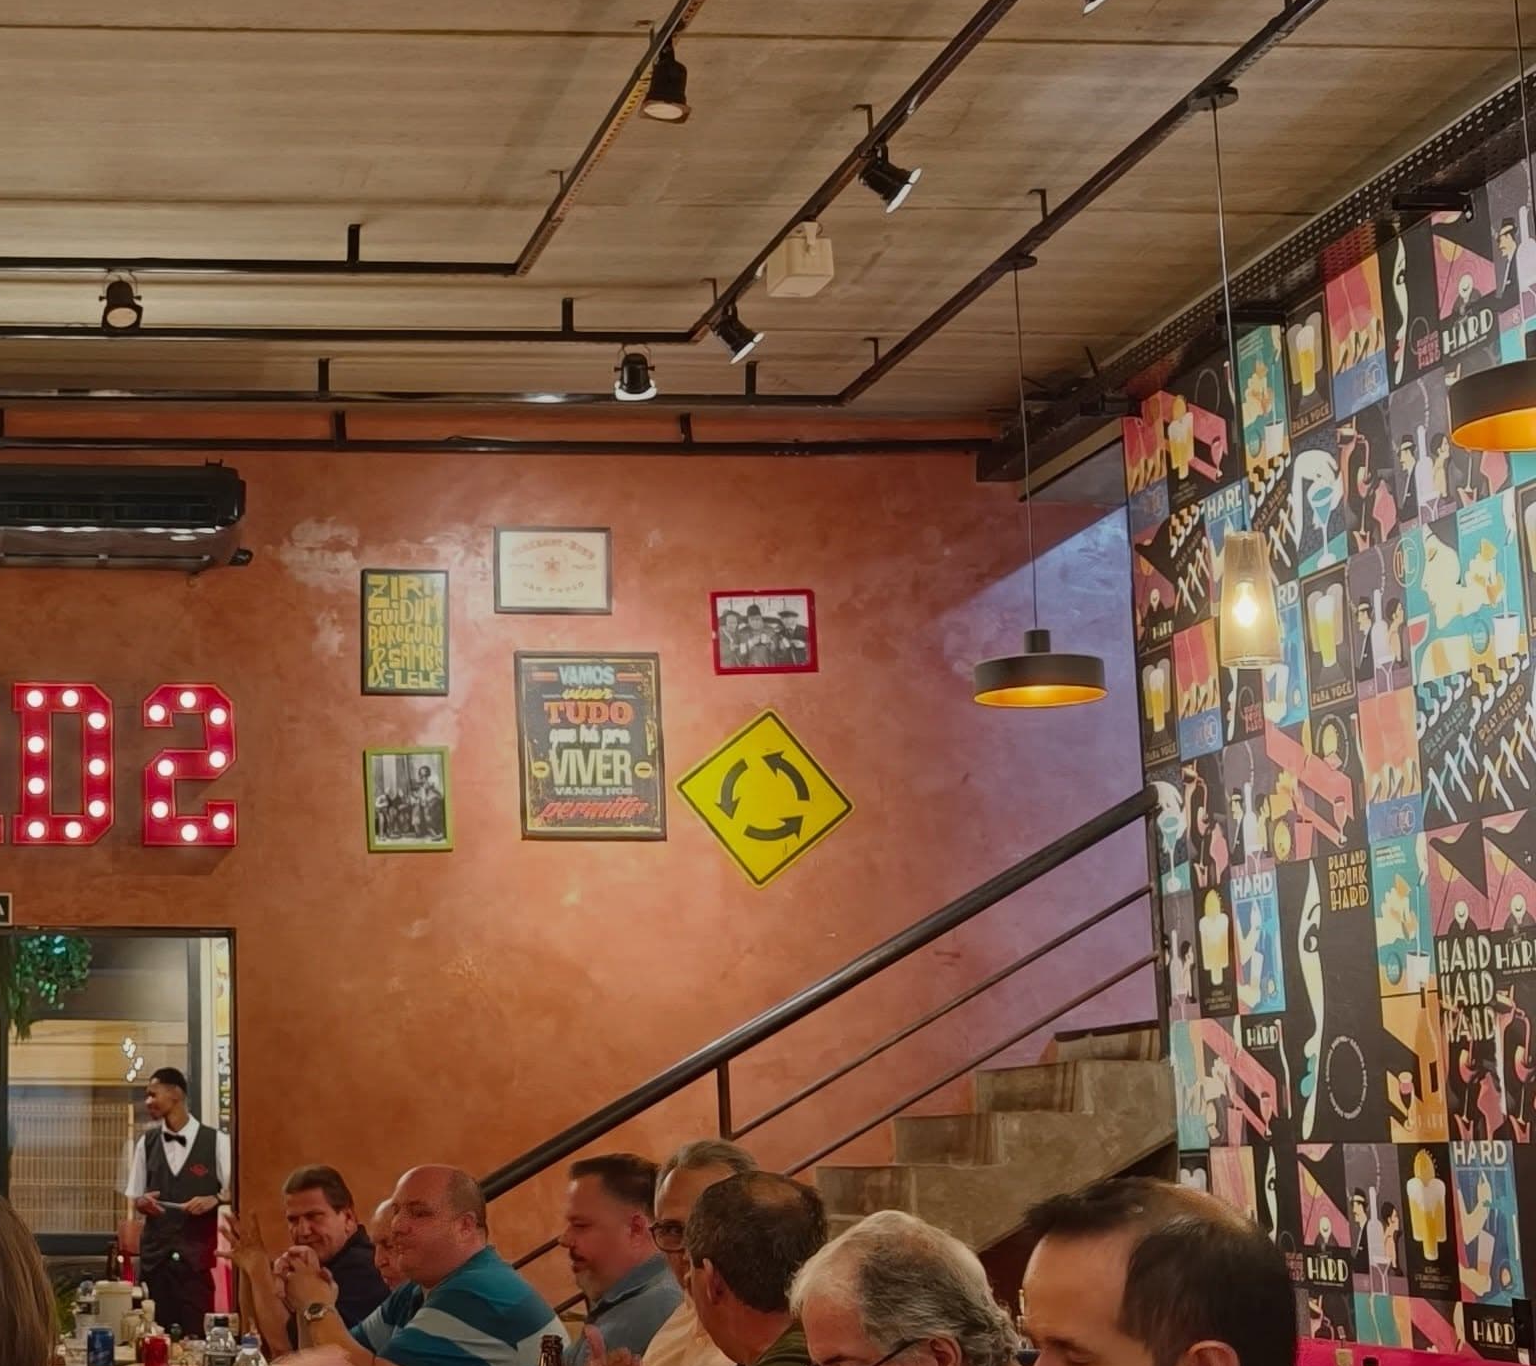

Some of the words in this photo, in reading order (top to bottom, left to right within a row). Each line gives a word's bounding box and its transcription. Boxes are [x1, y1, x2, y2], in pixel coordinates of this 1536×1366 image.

[1442, 309, 1493, 355] HARD
[1277, 582, 1299, 608] RD
[559, 666, 613, 685] VAMOS
[544, 701, 634, 724] TUDO
[550, 749, 632, 785] VIVER
[554, 787, 602, 796] VAMOS
[1231, 873, 1273, 898] HARD
[1329, 865, 1368, 889] DRINK
[1330, 885, 1369, 911] HARD
[1438, 935, 1491, 973] HARD
[1495, 939, 1536, 969] HAR
[1453, 1139, 1507, 1166] HARD
[1306, 1256, 1349, 1282] HARD
[1472, 1319, 1514, 1345] HARD
